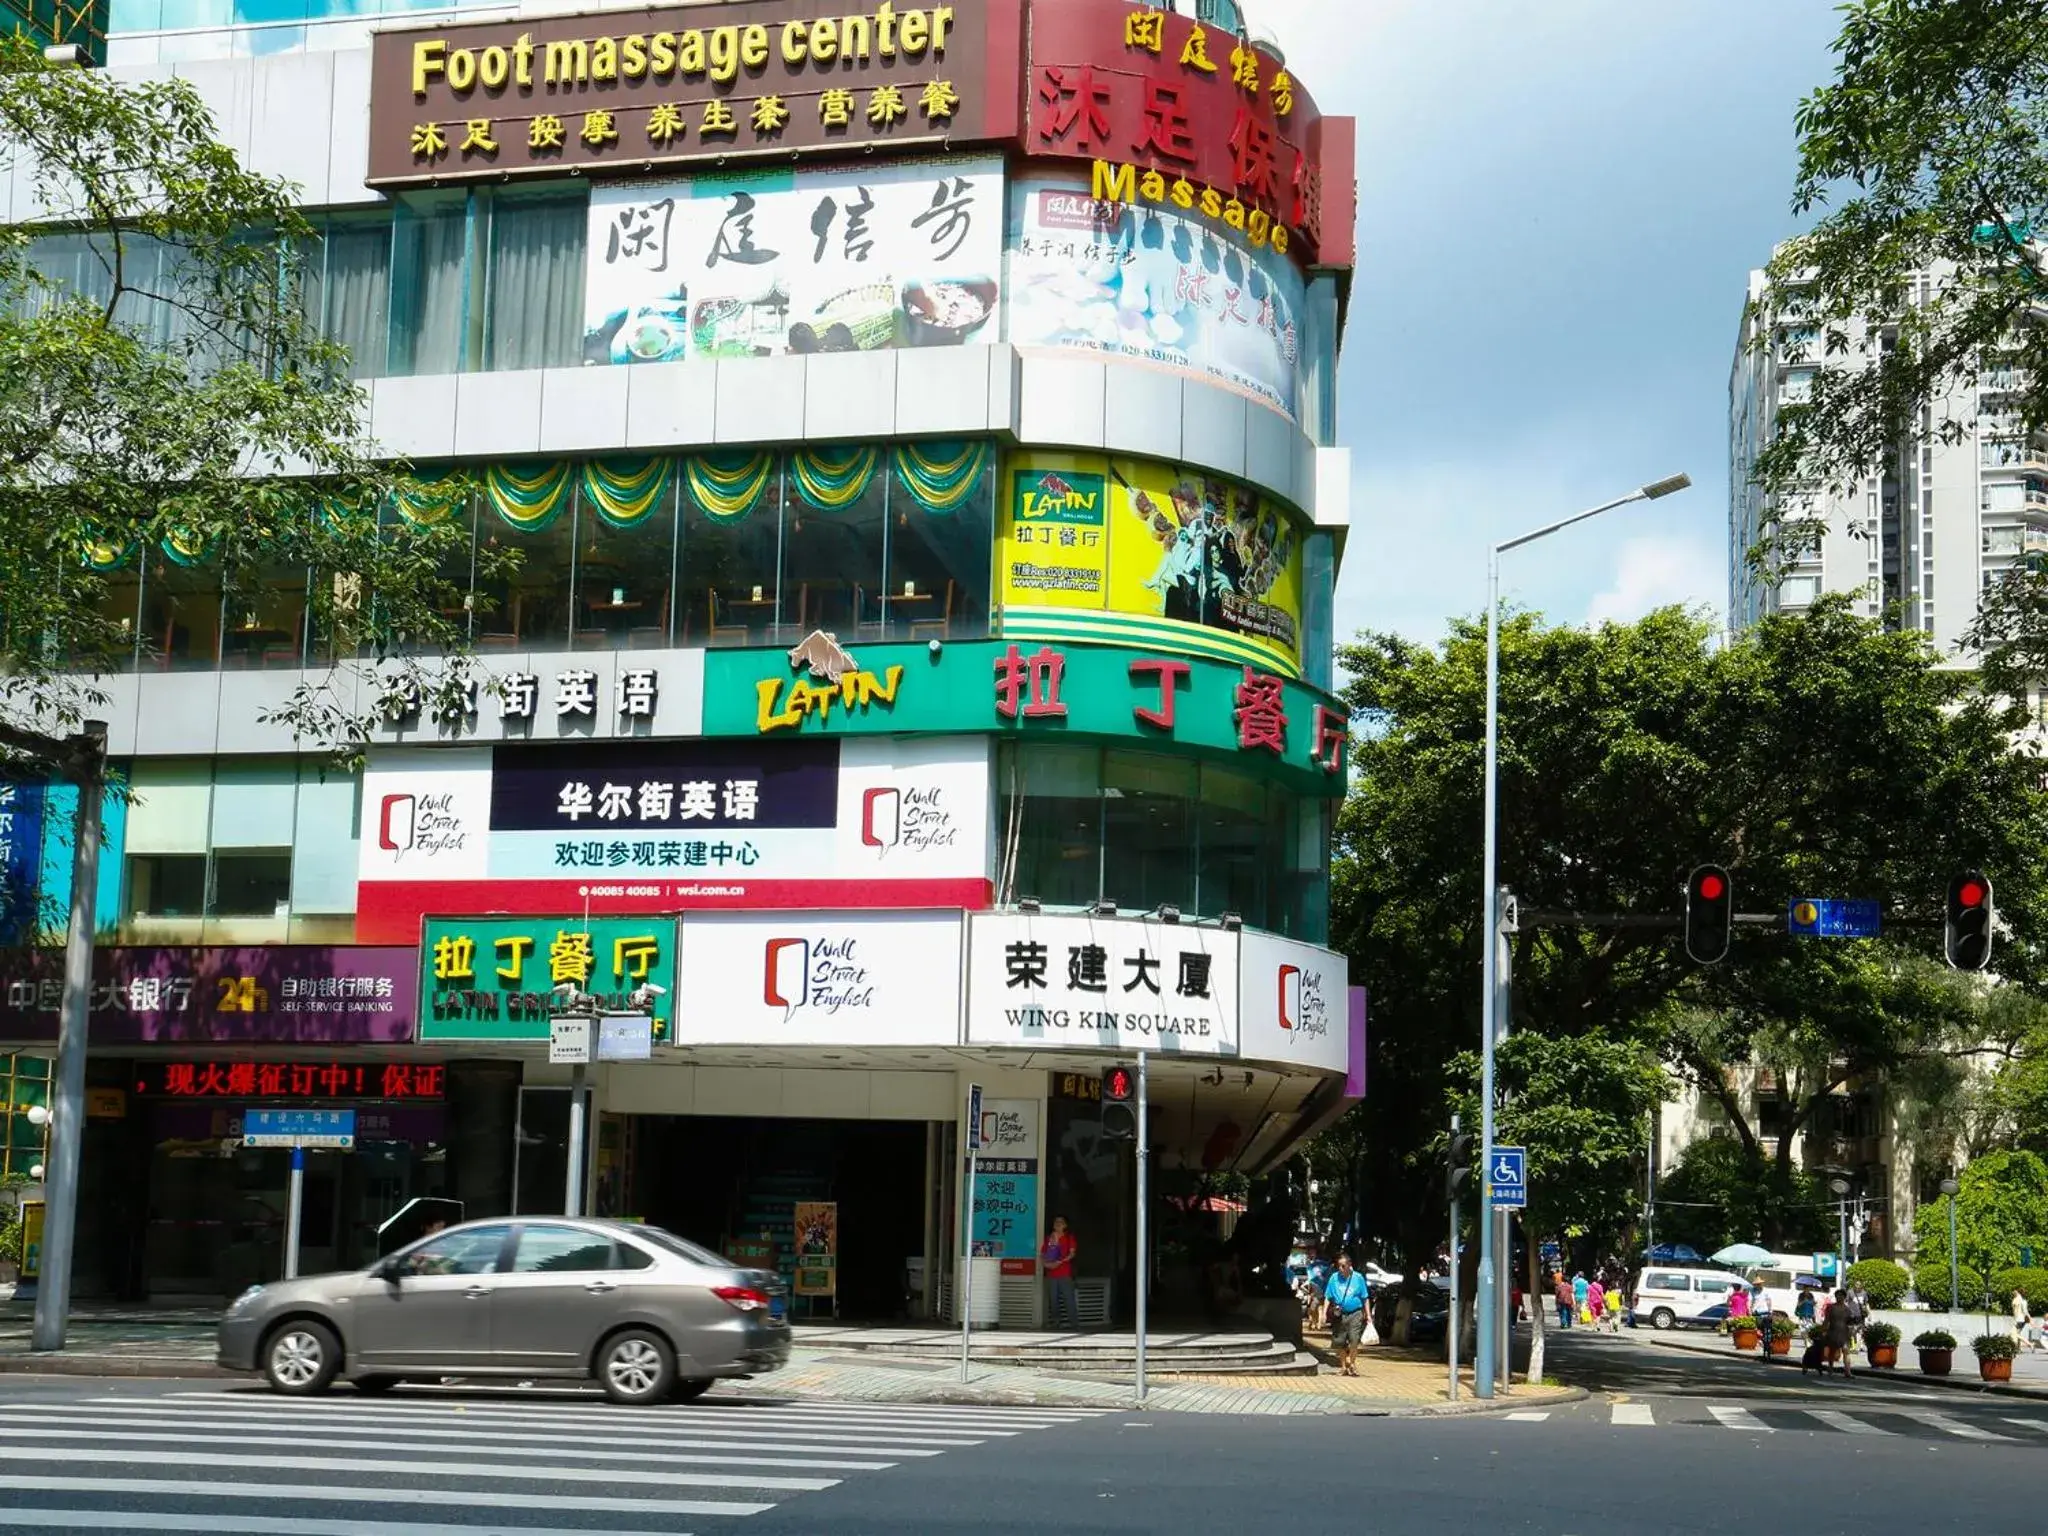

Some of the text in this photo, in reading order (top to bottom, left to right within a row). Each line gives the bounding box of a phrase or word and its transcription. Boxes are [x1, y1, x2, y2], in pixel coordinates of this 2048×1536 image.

[411, 1, 954, 95] Foot massage center
[411, 80, 958, 160] 沐足 按摩 养生茶 营养餐
[1092, 158, 1288, 254] Massage
[1022, 492, 1097, 518] LATIN
[1016, 526, 1099, 547] 拉丁餐厅
[755, 663, 904, 734] LATIN
[994, 644, 1347, 773] 拉丁餐厅
[418, 793, 453, 813] Wall
[557, 779, 760, 822] 华尔街英语
[903, 786, 941, 806] Wall
[417, 812, 462, 831] Street
[903, 806, 949, 826] Street
[416, 833, 466, 856] English
[903, 827, 957, 853] English
[554, 839, 760, 868] 欢迎参观荣建中心
[590, 885, 624, 897] 40085
[626, 885, 661, 897] 40085
[433, 931, 658, 983] 拉丁餐厅
[812, 937, 856, 960] Wall
[812, 960, 870, 983] Street
[1005, 940, 1212, 1000] 荣建大厦
[8, 977, 268, 1012] 中国大银行 24h
[281, 977, 394, 998] 自助银行服务
[348, 1001, 393, 1013] BANKING
[432, 990, 499, 1010] LATIN
[812, 986, 874, 1015] English
[1005, 1009, 1211, 1036] WING KIN SQUARE
[986, 1181, 1016, 1196] 欢迎
[973, 1200, 1028, 1214] 参观中心
[988, 1218, 1013, 1236] 2F
[1818, 1257, 1833, 1273] P
